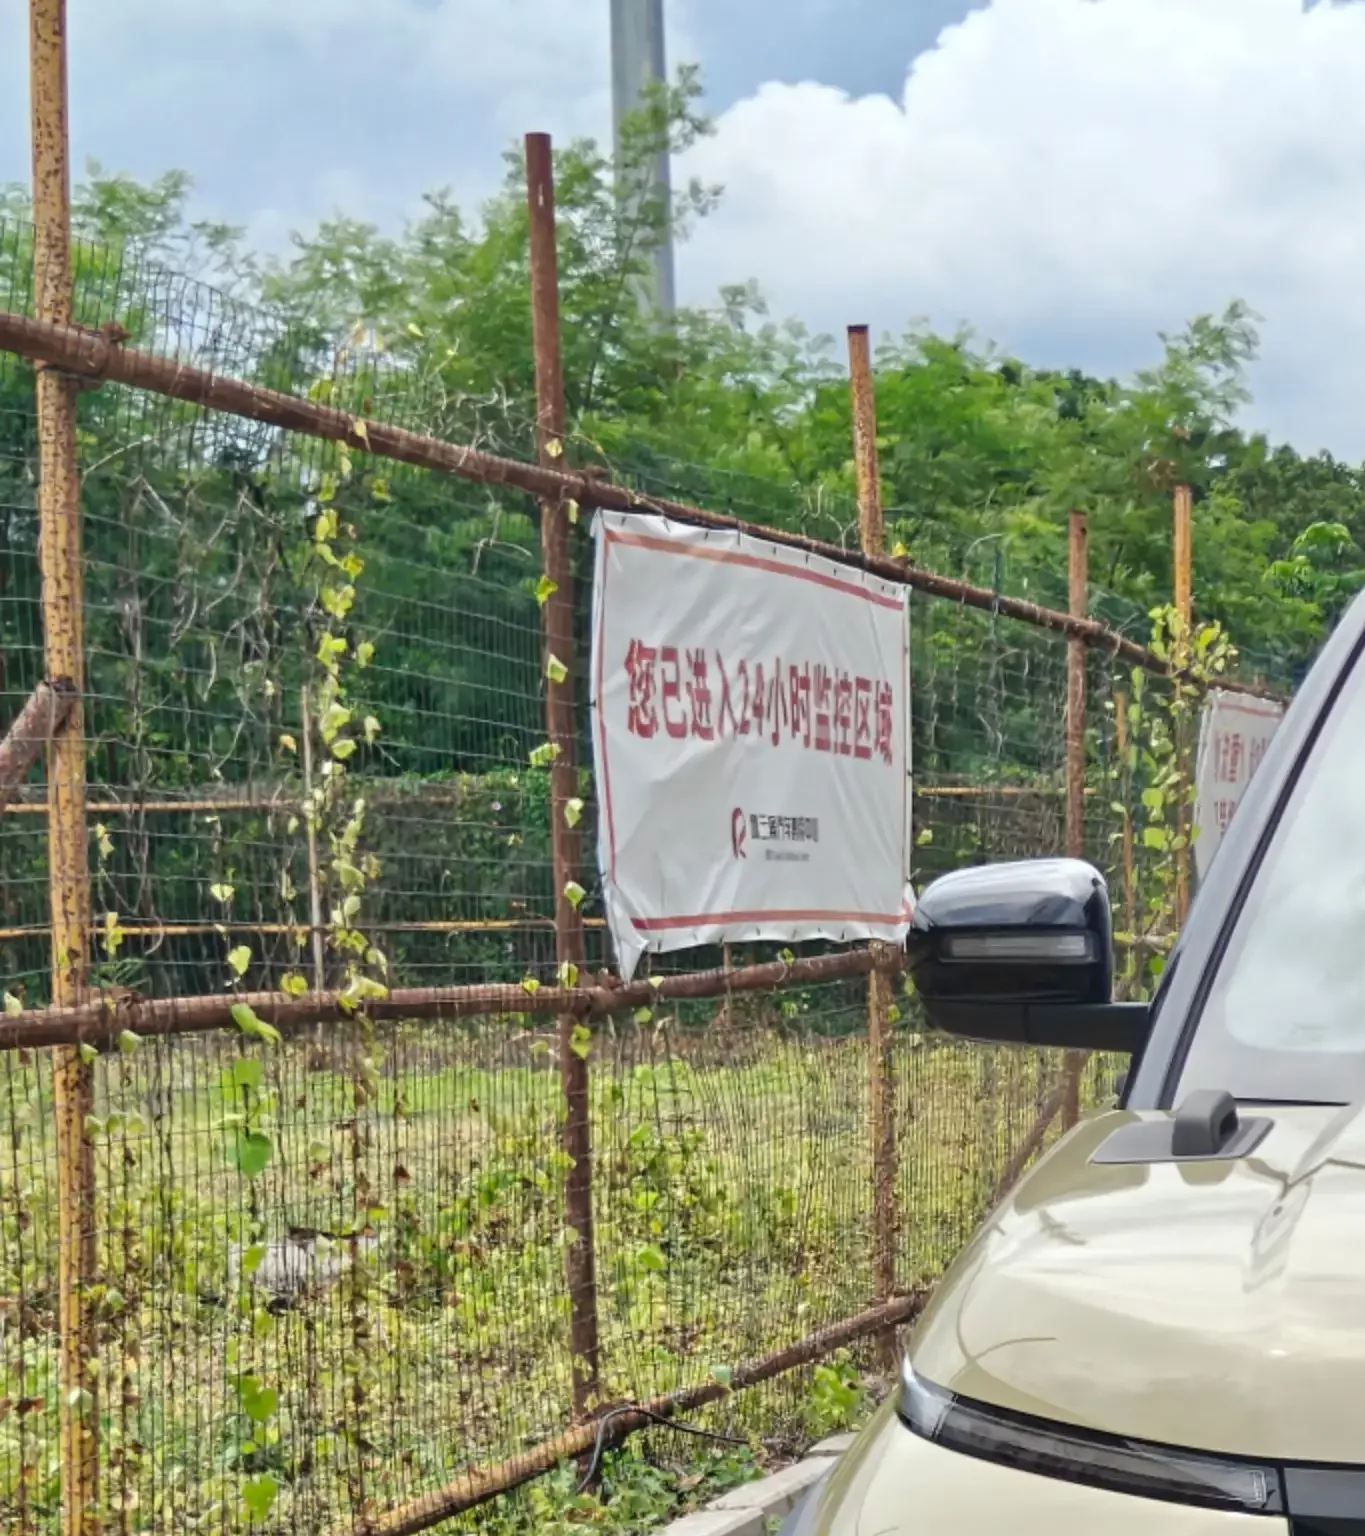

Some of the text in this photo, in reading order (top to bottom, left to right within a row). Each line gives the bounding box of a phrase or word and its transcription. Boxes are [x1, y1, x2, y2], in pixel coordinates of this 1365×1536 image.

[625, 638, 892, 765] 您已进入24小时监控区域
